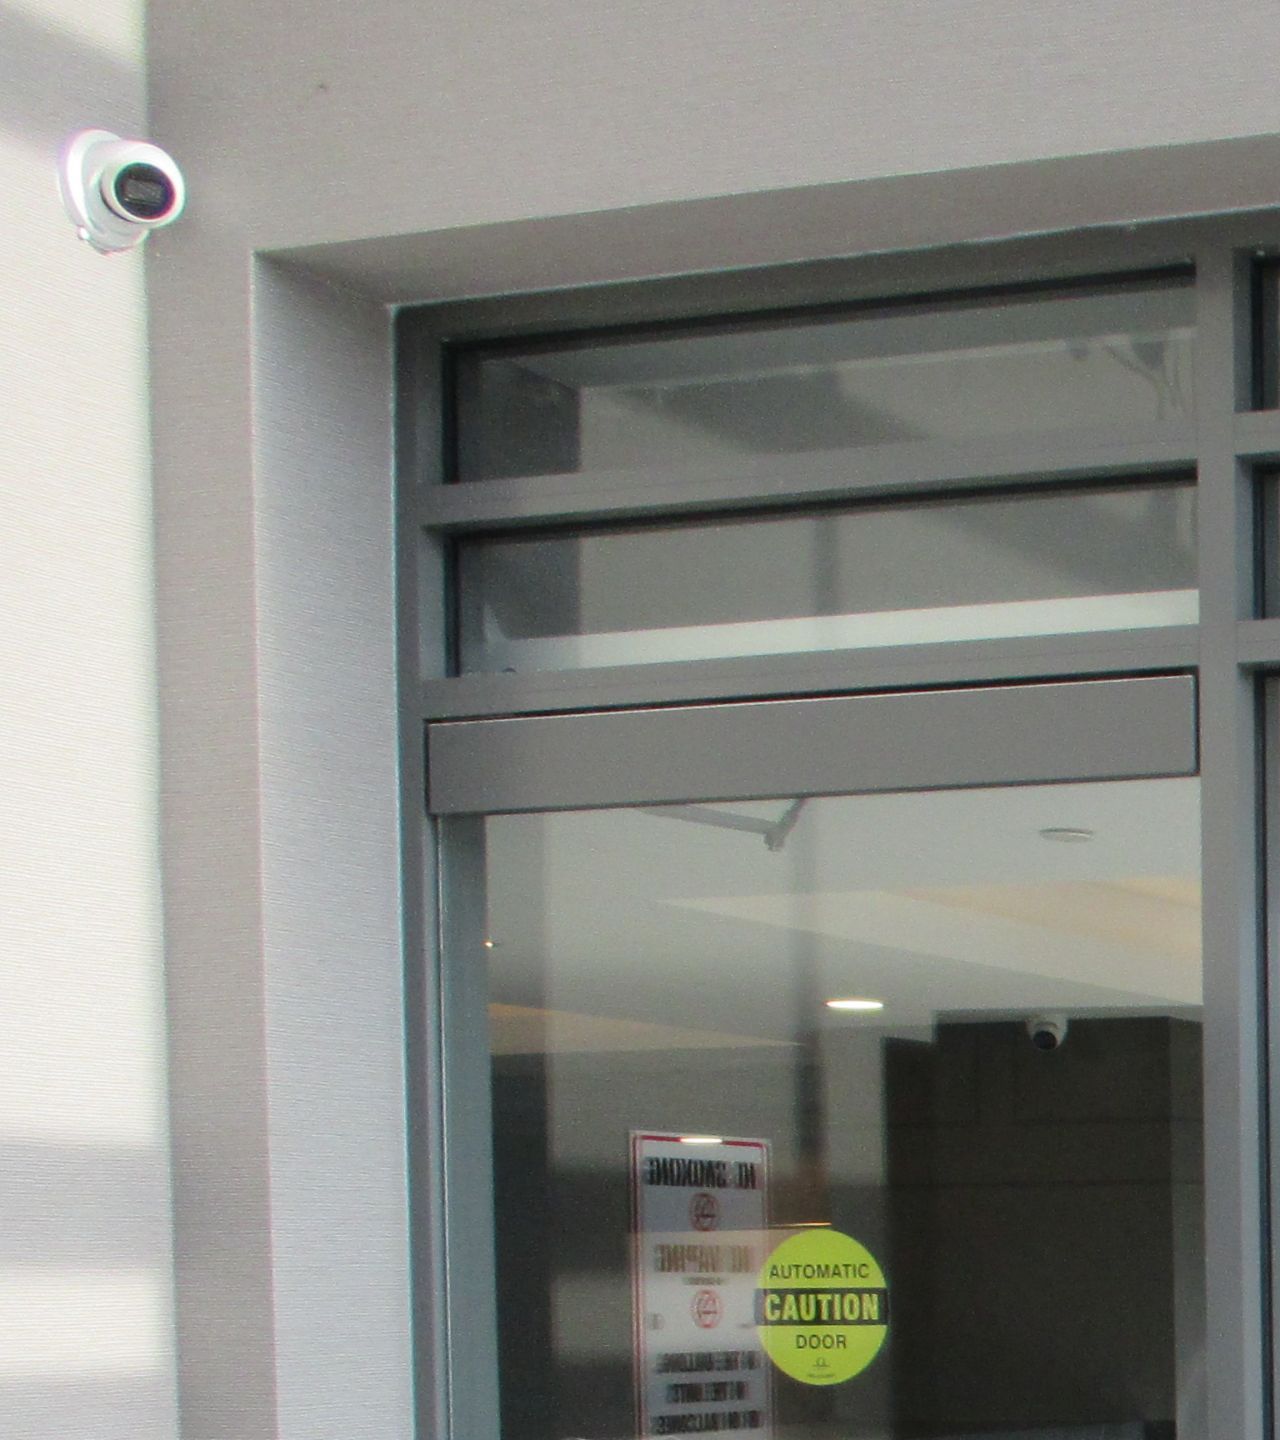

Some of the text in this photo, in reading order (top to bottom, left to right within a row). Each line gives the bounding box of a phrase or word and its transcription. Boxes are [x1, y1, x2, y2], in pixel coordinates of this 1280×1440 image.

[770, 1263, 869, 1279] AUTOMATIC
[765, 1293, 879, 1321] CAUTION
[796, 1333, 847, 1349] DOOR
